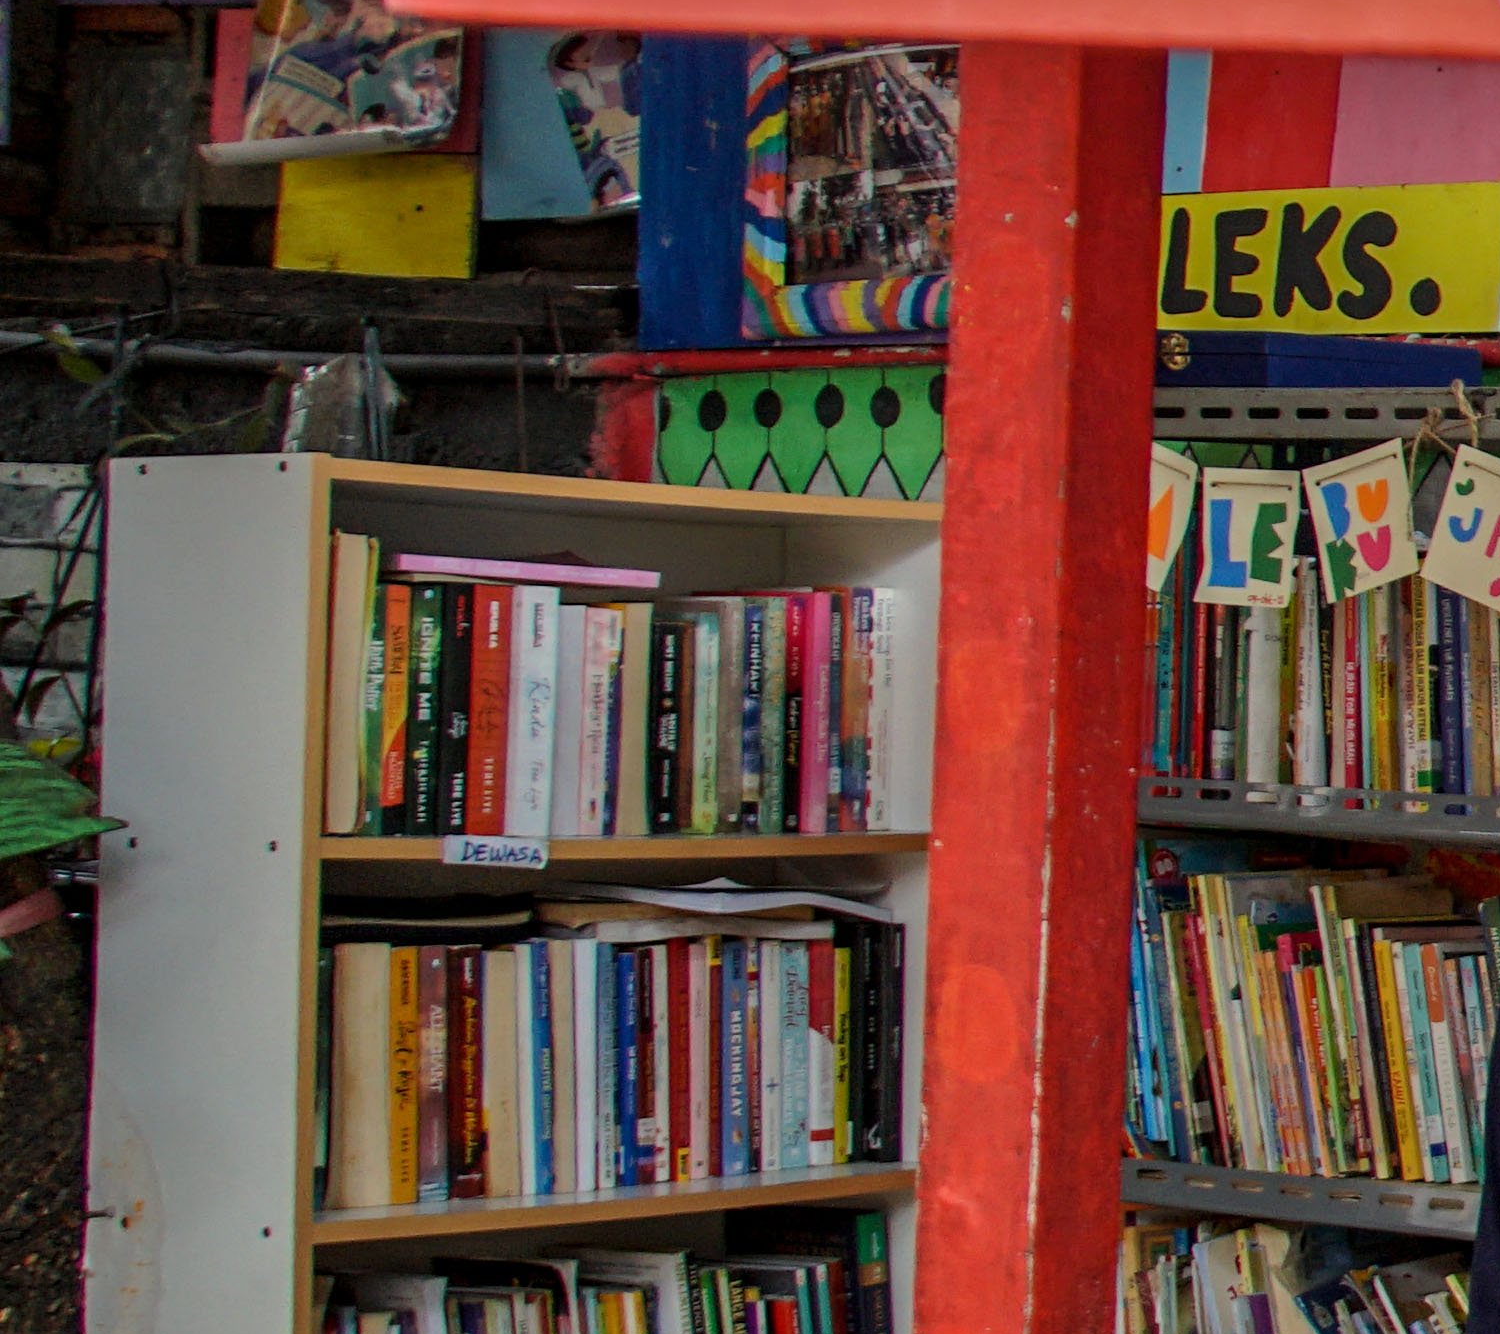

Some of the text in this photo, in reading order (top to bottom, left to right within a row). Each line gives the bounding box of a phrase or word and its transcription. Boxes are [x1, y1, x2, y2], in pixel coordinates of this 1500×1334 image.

[418, 617, 435, 684] IGNITE
[417, 692, 433, 721] ME
[461, 841, 543, 865] DEWASA
[730, 1010, 743, 1116] MOCKINGJAY
[728, 1279, 747, 1319] LANCE
